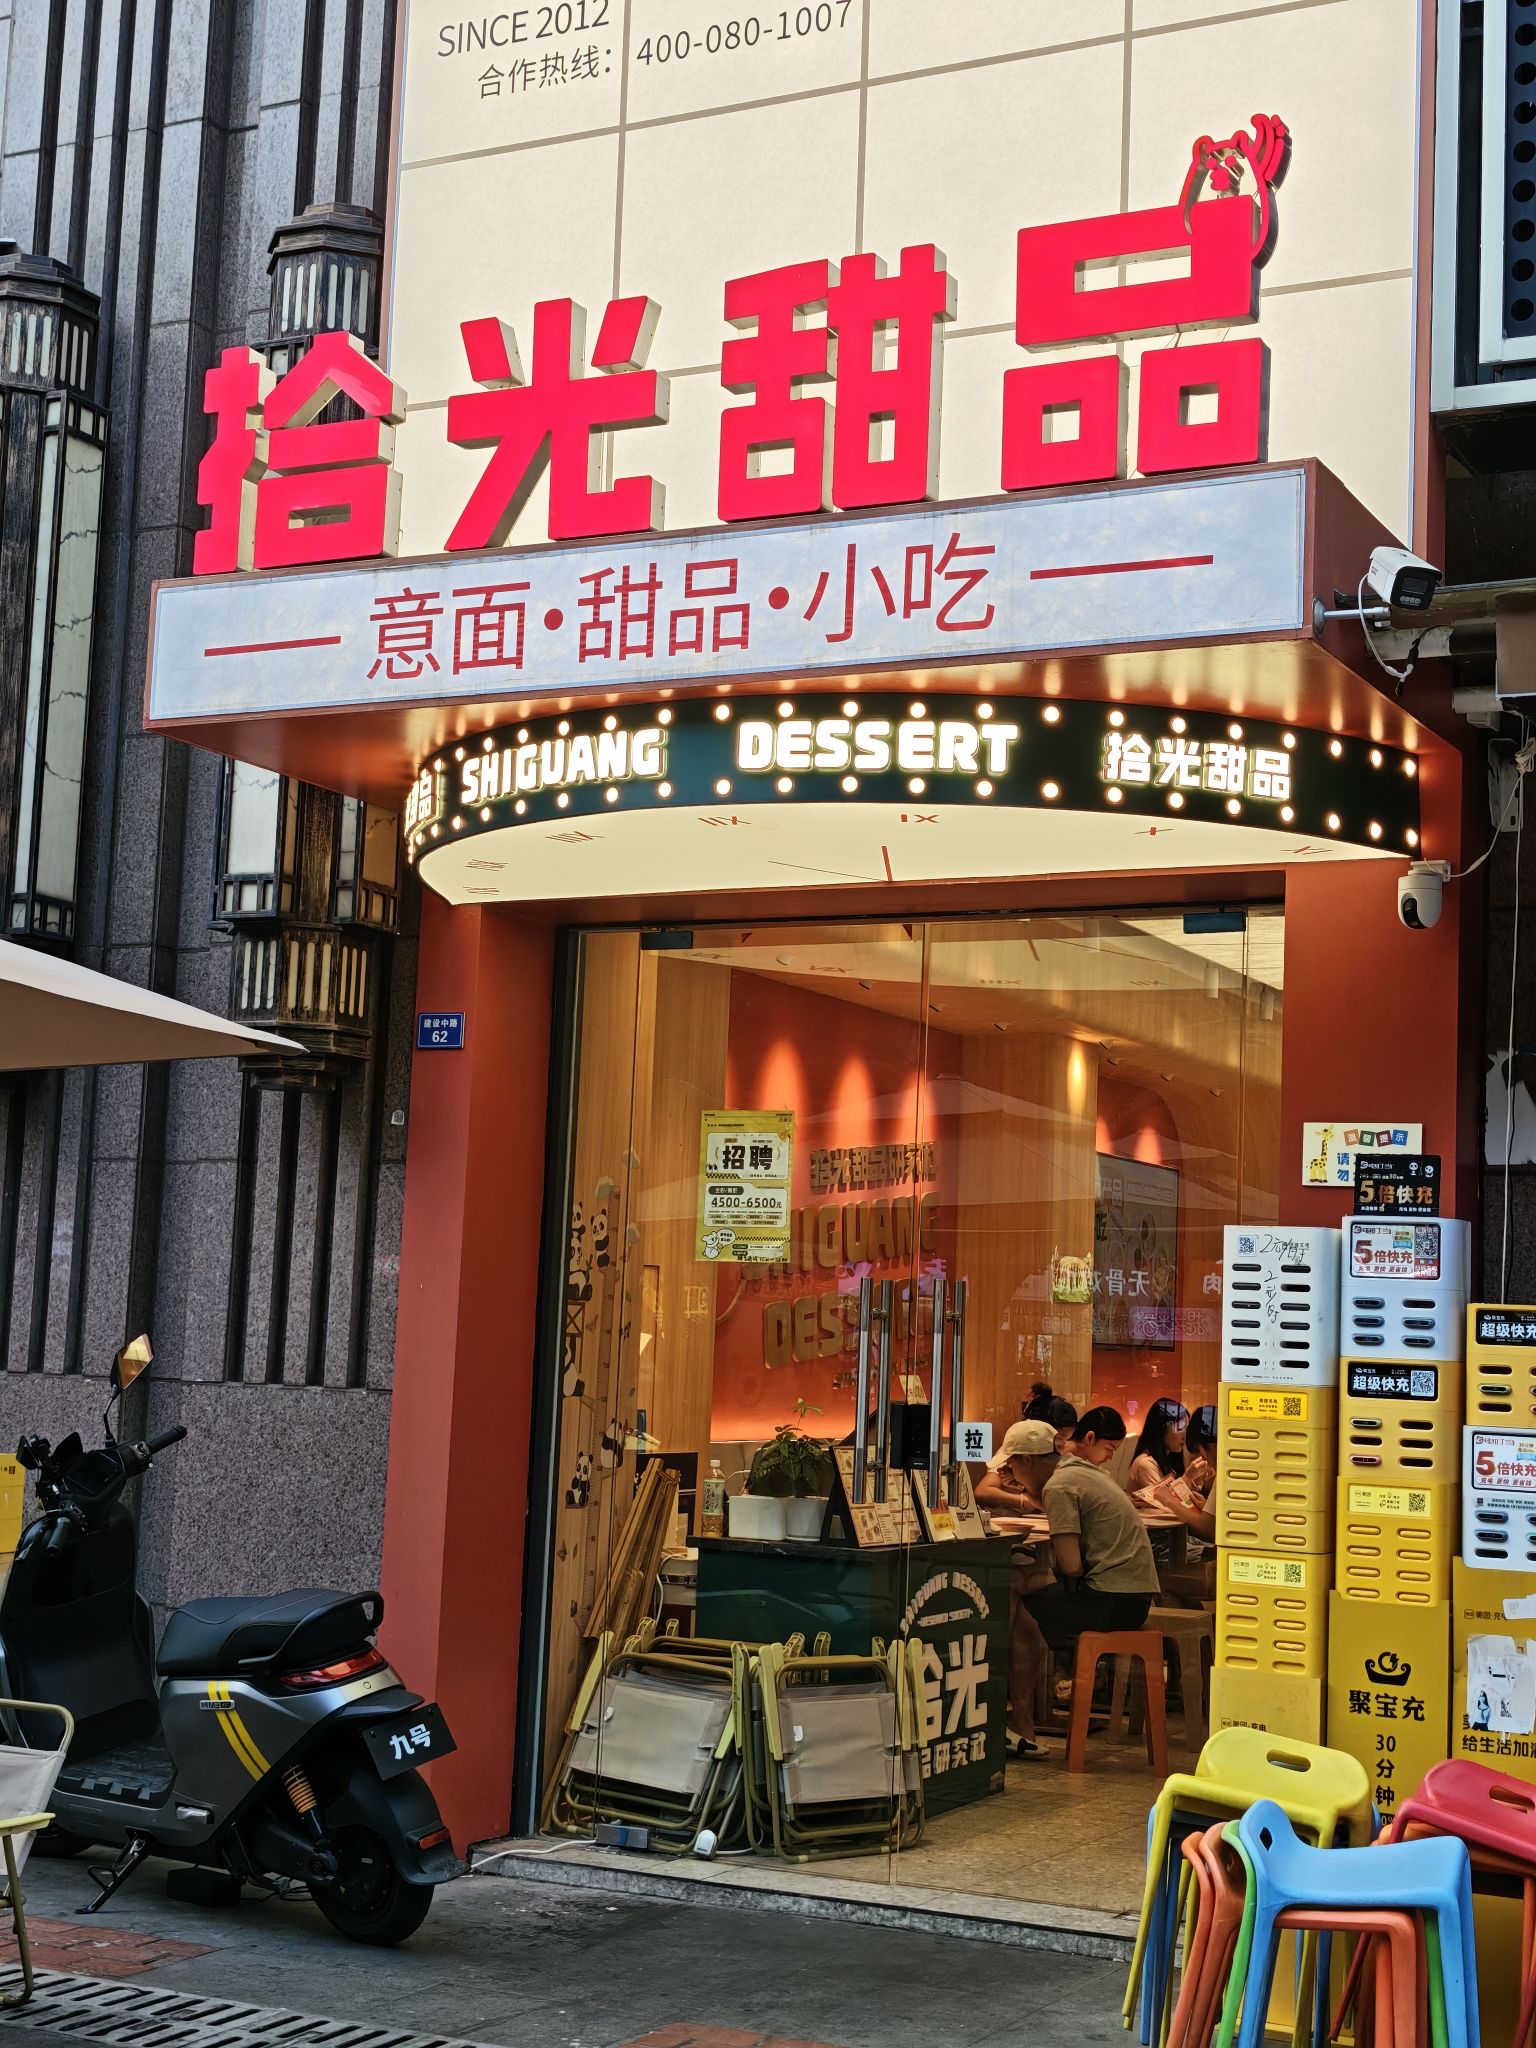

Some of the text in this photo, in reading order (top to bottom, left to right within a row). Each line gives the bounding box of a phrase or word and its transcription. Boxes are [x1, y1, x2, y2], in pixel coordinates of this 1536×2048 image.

[436, 0, 611, 58] SINCE 2012
[637, 0, 853, 66] 400-080-1007
[193, 195, 1272, 574] 拾光甜品
[461, 719, 1019, 804] SHIGUANG DESSERT
[1104, 731, 1293, 800] 拾光甜品
[423, 1018, 458, 1029] 建设中路
[432, 1030, 448, 1043] 62
[1346, 1132, 1406, 1143] 温馨提示
[722, 1145, 773, 1170] 招聘
[1360, 1180, 1433, 1204] 5倍快充
[1354, 1240, 1413, 1264] 5倍快充
[1481, 1322, 1536, 1339] 超级快充
[1353, 1375, 1410, 1392] 超级快充
[964, 1428, 984, 1450] 拉
[1476, 1451, 1536, 1477] 5倍快充
[1349, 1690, 1425, 1722] 聚宝充
[389, 1723, 431, 1760] 九号
